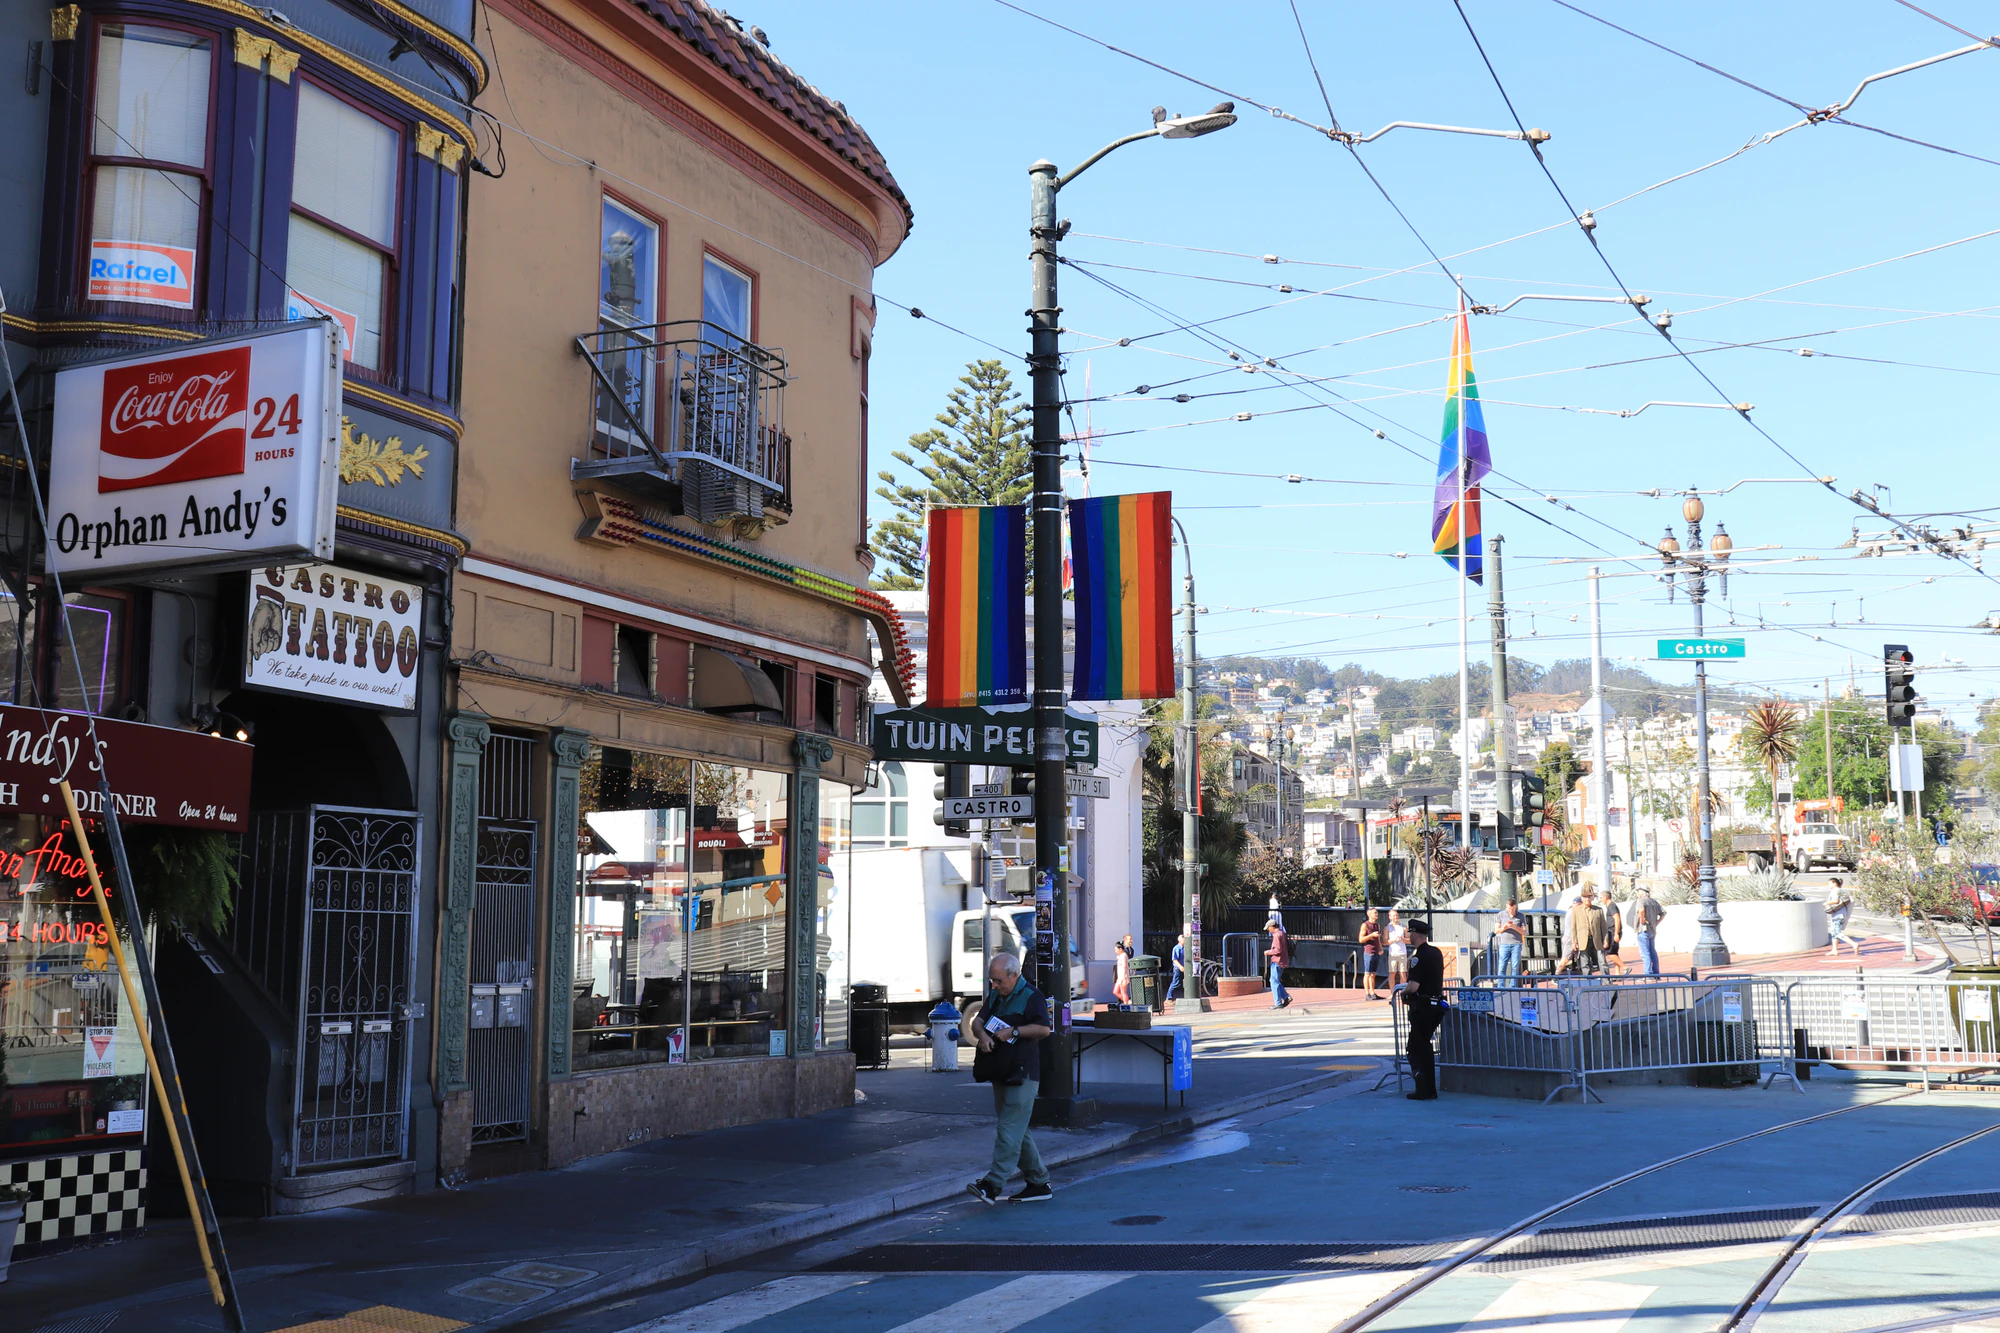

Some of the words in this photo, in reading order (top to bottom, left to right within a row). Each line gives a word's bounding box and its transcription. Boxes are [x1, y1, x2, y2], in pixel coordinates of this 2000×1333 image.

[91, 258, 176, 284] Rafael
[148, 371, 174, 384] Enjoy
[110, 368, 237, 434] Coca-Cola
[250, 393, 303, 439] 24
[254, 447, 295, 461] HOURS
[56, 506, 167, 559] Orphan
[178, 486, 287, 540] Andy's
[265, 566, 410, 614] CASTRO
[285, 601, 418, 678] TATTOO
[1675, 643, 1728, 655] Castro
[266, 658, 285, 676] We
[284, 663, 308, 680] take
[305, 672, 338, 687] pride
[340, 677, 350, 688] in
[352, 682, 369, 692] our
[885, 719, 972, 752] TWIN
[984, 725, 1090, 757] PES
[983, 785, 999, 794] 400
[1069, 779, 1087, 792] 17TH
[1093, 780, 1102, 793] ST
[179, 800, 201, 821] Open
[204, 804, 217, 820] 24
[219, 805, 238, 823] hours
[953, 800, 1021, 815] CASTRO
[31, 922, 109, 944] HOURS
[89, 1028, 103, 1036] STOP
[104, 1028, 114, 1036] THE
[87, 1062, 112, 1071] VIOLENCE
